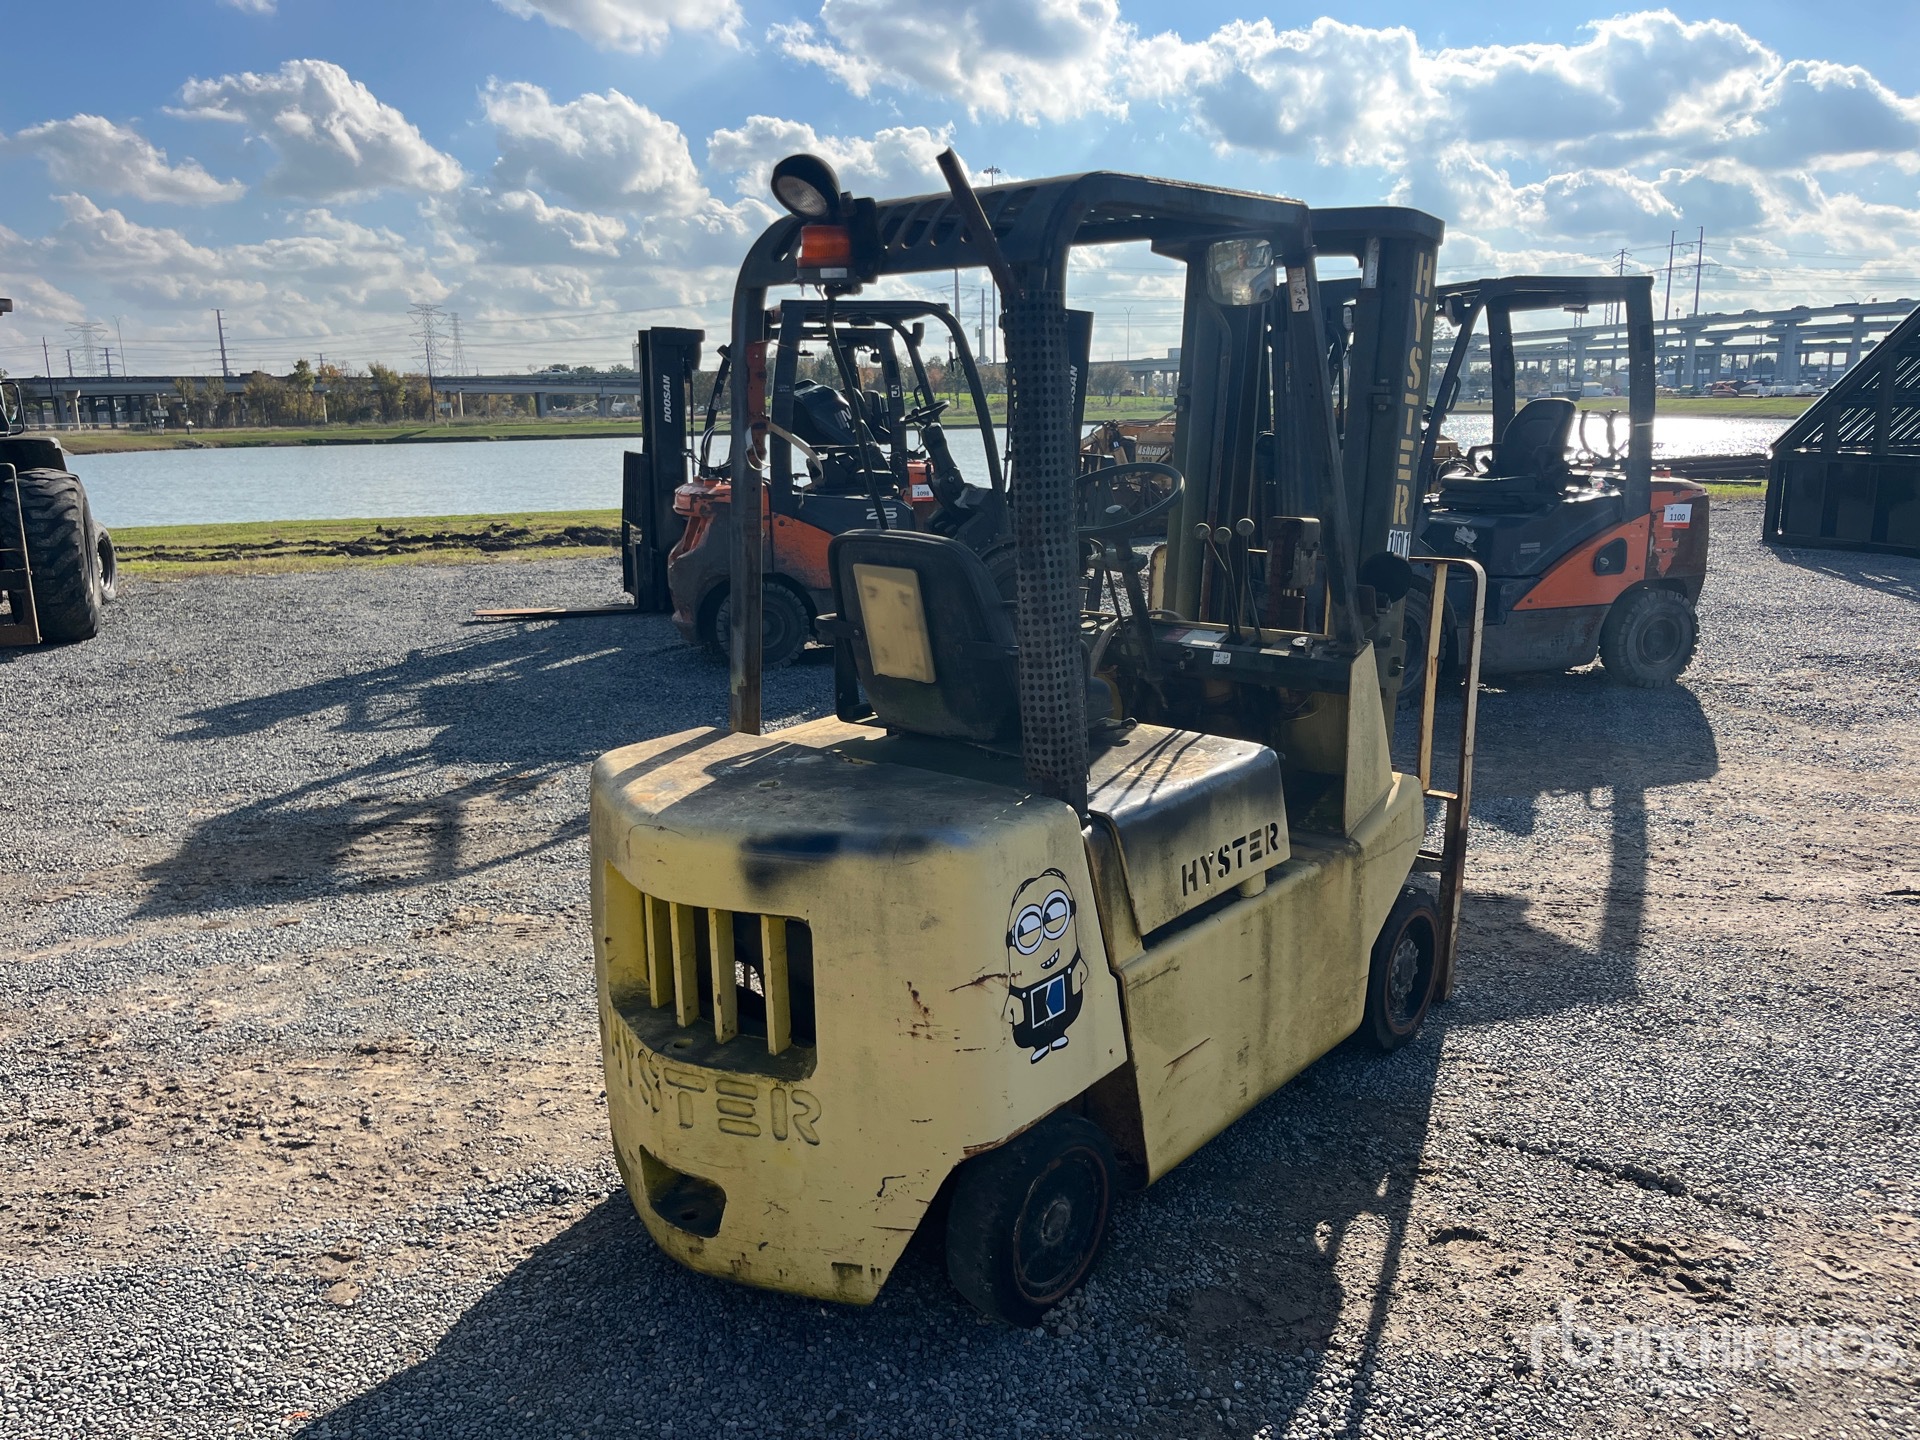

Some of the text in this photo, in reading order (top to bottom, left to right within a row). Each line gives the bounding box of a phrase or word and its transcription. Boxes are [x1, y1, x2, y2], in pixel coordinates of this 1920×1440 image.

[662, 374, 672, 423] DOOSAN
[1392, 251, 1433, 525] HYSTER
[1137, 444, 1166, 456] Ashland
[866, 507, 898, 520] 25
[1669, 513, 1686, 521] 1100
[1181, 822, 1279, 897] HYSTER
